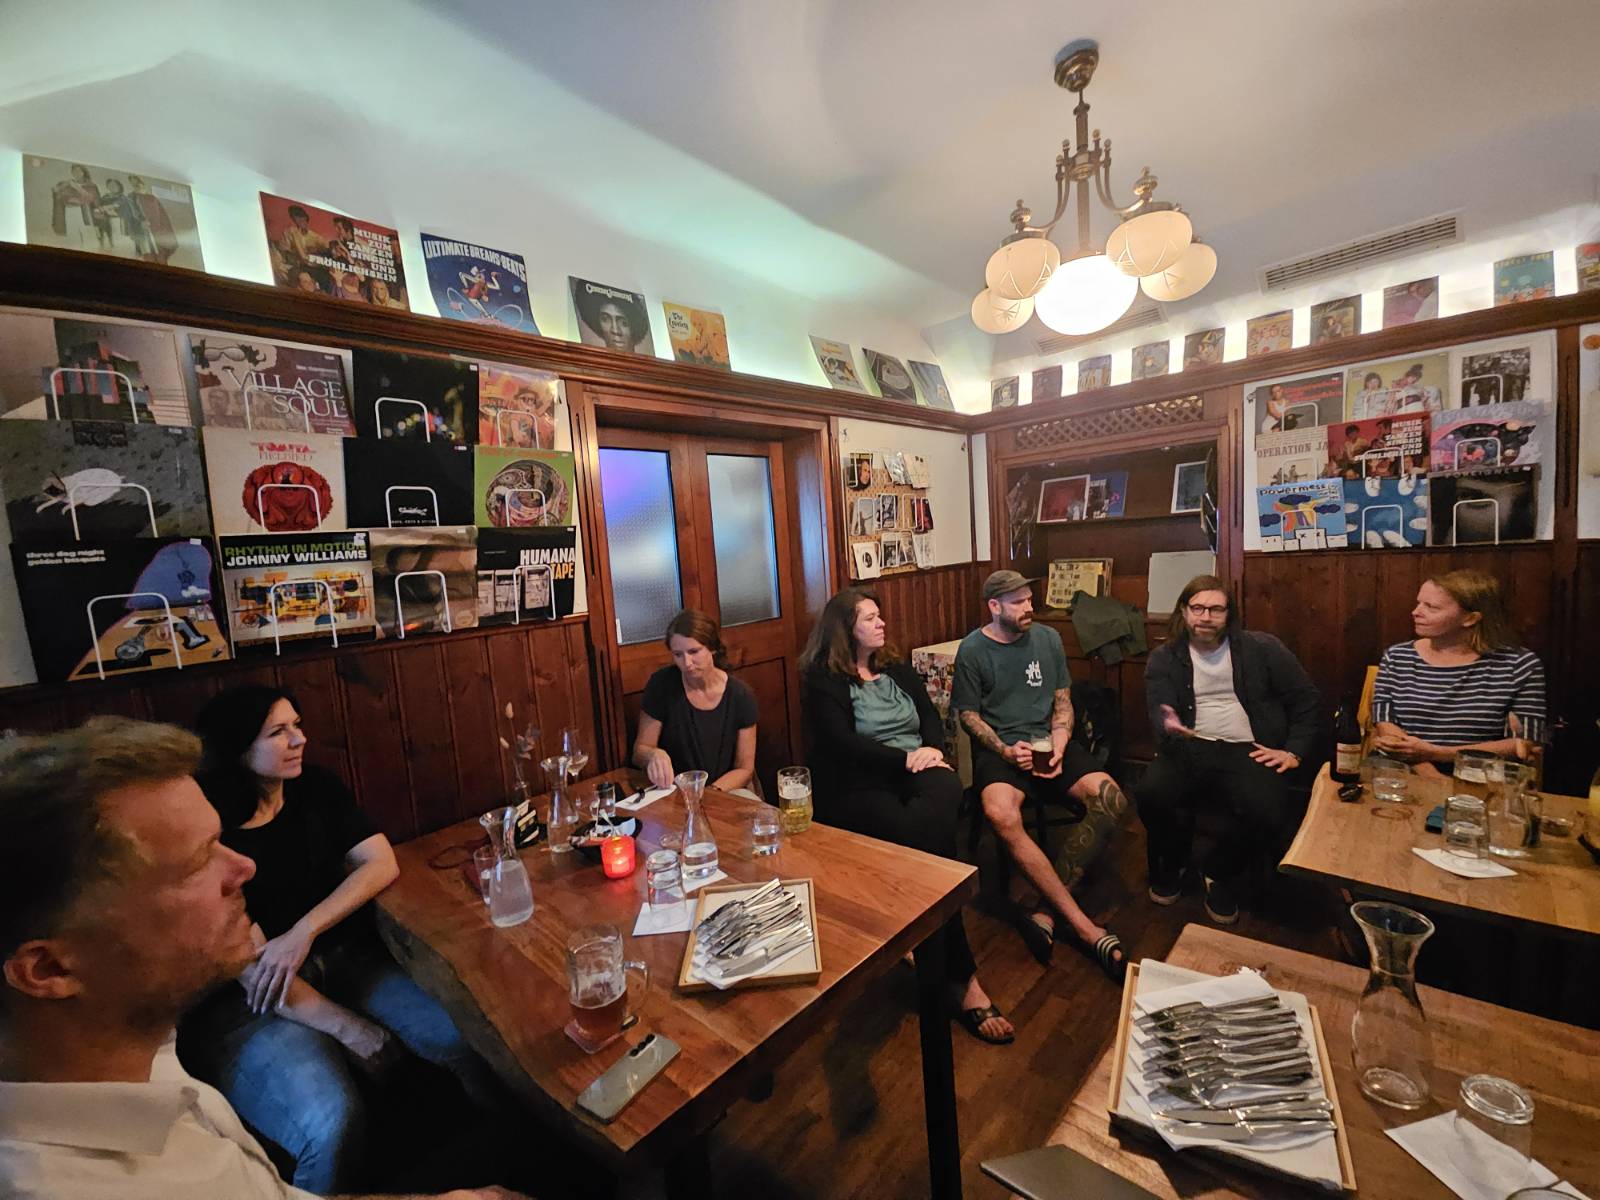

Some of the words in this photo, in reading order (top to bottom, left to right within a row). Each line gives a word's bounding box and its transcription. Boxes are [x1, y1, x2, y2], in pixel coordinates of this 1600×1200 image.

[353, 227, 391, 244] MUSIK
[347, 241, 393, 259] TANZEN
[368, 240, 392, 252] ZUM
[371, 263, 396, 275] UND
[424, 240, 470, 259] ULTIMATE
[469, 244, 501, 267] BREAKS
[501, 255, 528, 283] BEATS
[227, 369, 345, 400] VILLAGE
[273, 394, 349, 418] SOUL
[1257, 442, 1312, 458] OPERATION
[225, 544, 288, 557] RHYTHM
[292, 544, 307, 553] IN
[227, 553, 290, 567] JOHNNY
[294, 550, 367, 563] WILLIAMS
[520, 547, 576, 566] HUMANA
